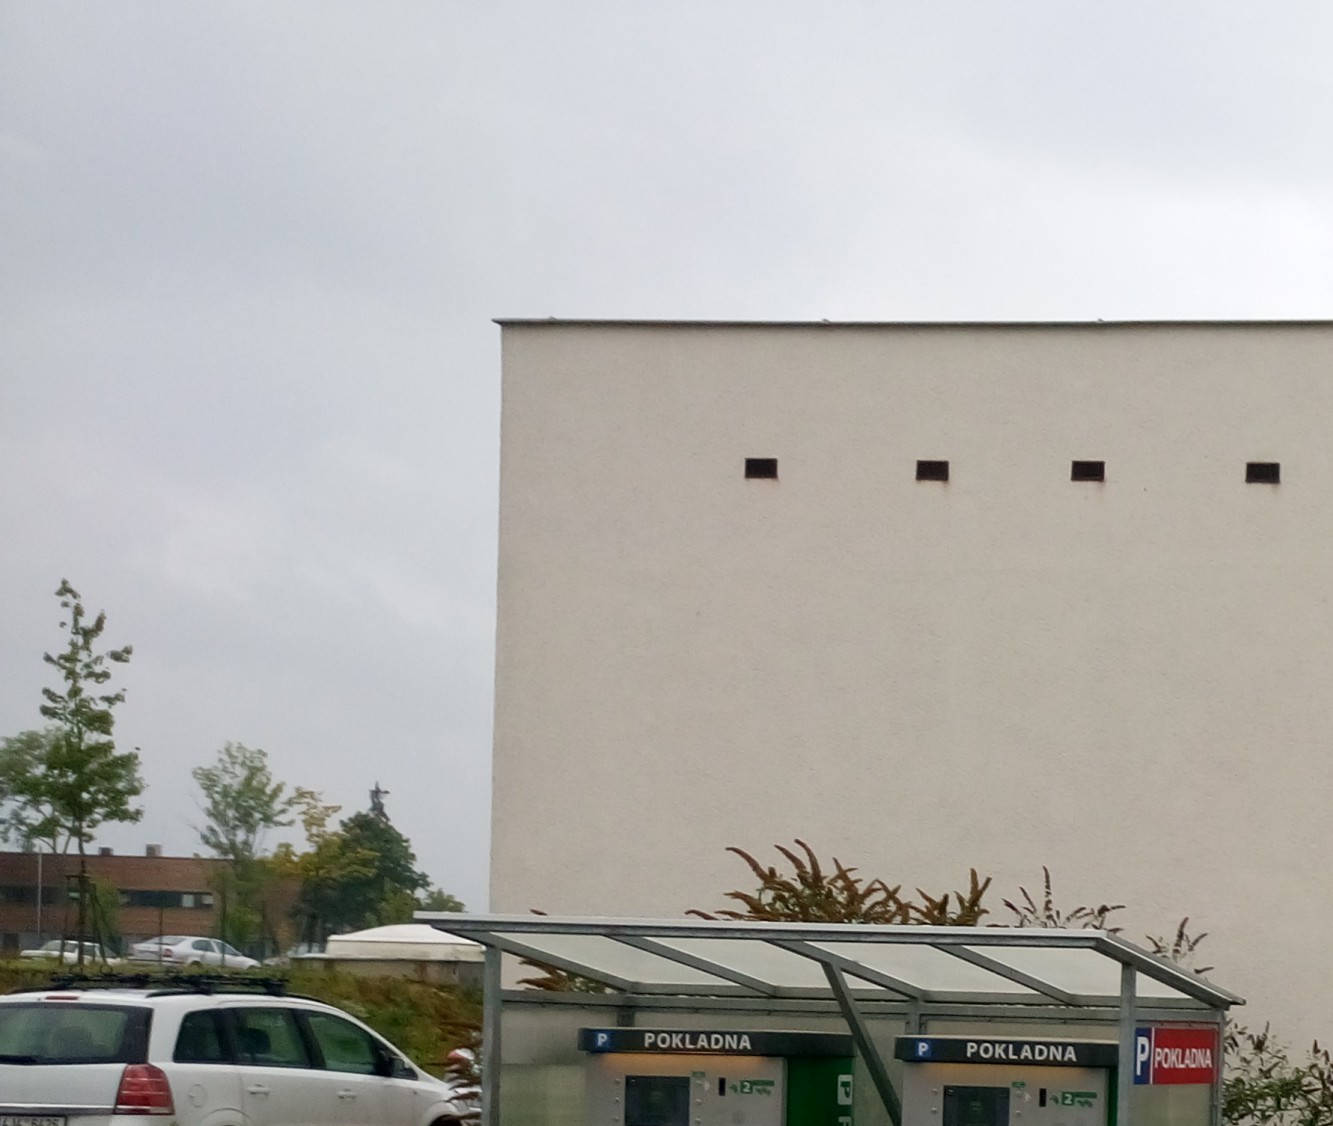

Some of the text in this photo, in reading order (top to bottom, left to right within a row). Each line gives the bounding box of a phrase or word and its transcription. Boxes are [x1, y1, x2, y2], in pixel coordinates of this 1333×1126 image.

[597, 1032, 752, 1051] P POKLADNA
[917, 1041, 1078, 1063] P POKLADNA
[1136, 1035, 1213, 1077] P POKLADNA
